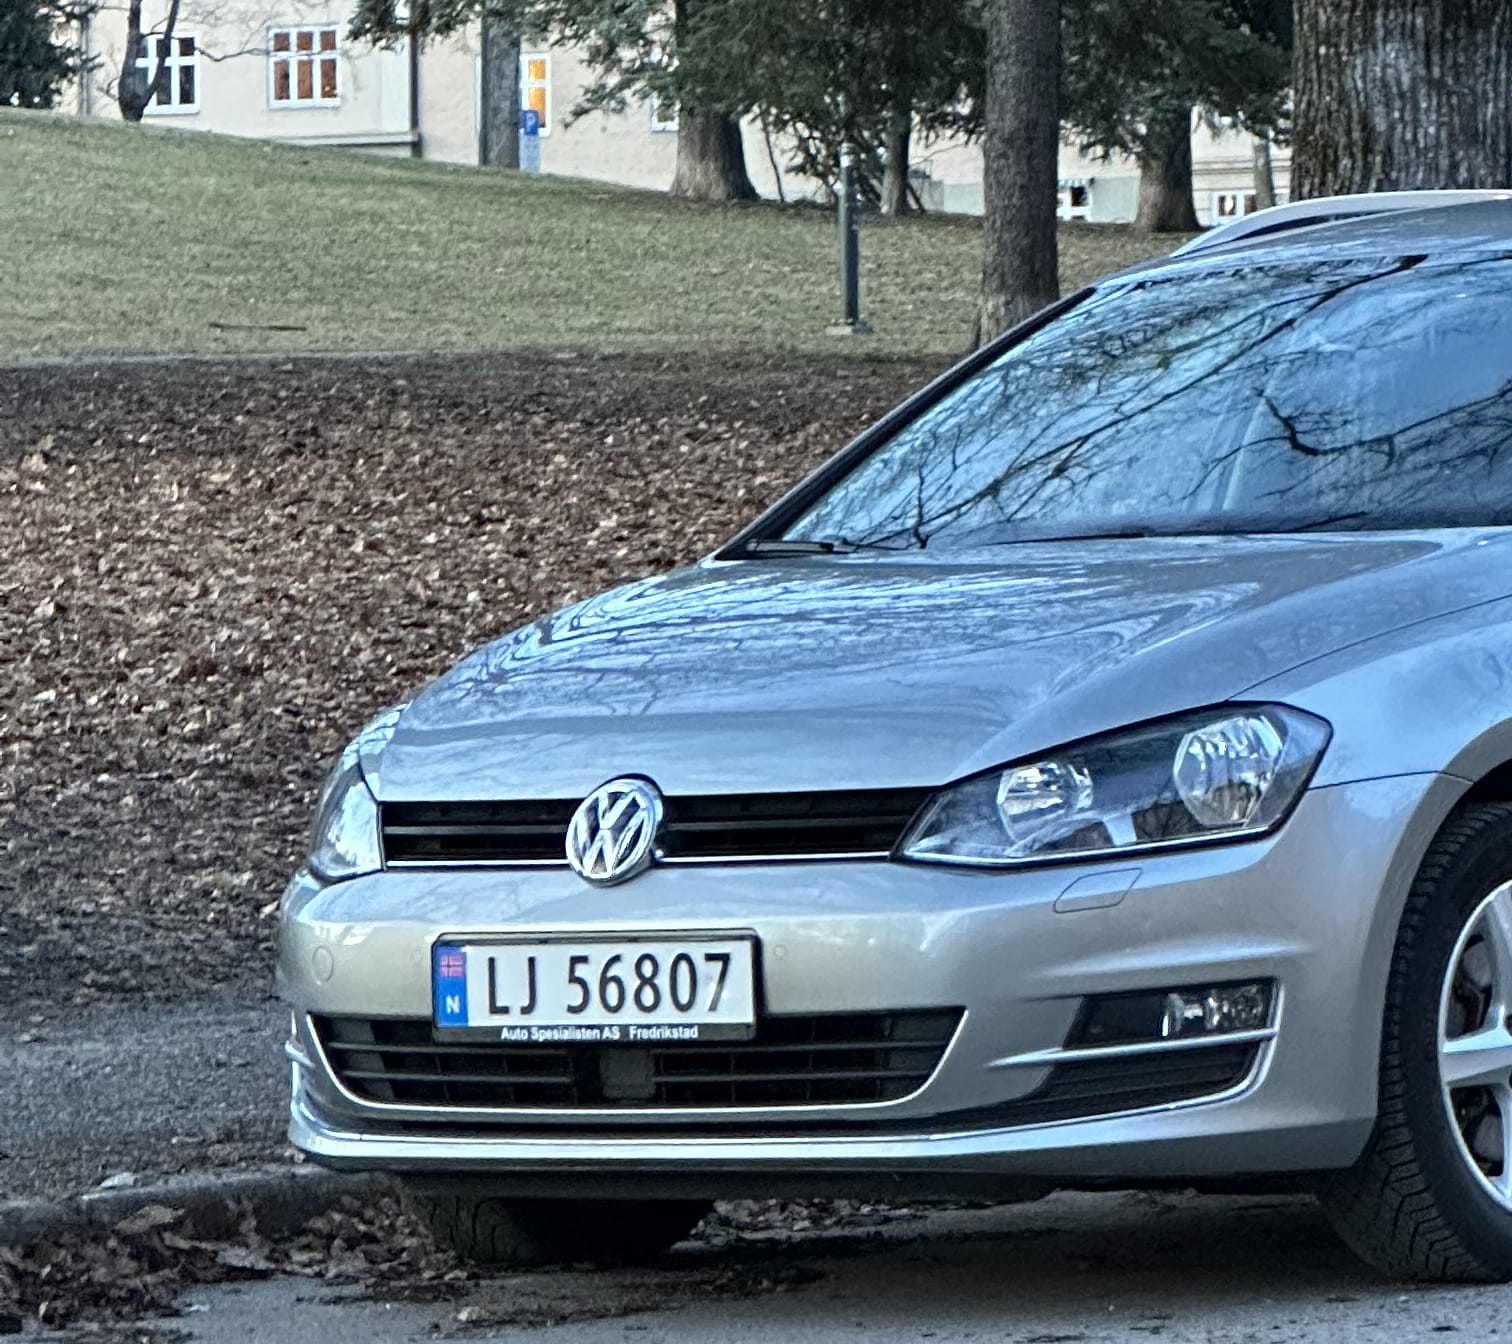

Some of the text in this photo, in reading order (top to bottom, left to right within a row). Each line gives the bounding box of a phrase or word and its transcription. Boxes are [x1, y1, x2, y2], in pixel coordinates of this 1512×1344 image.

[526, 112, 536, 133] P
[565, 778, 657, 879] VW
[488, 952, 731, 1015] LJ 56807
[446, 995, 460, 1014] N
[501, 1024, 698, 1042] Auto Spesialisten AS Fredrikstad
